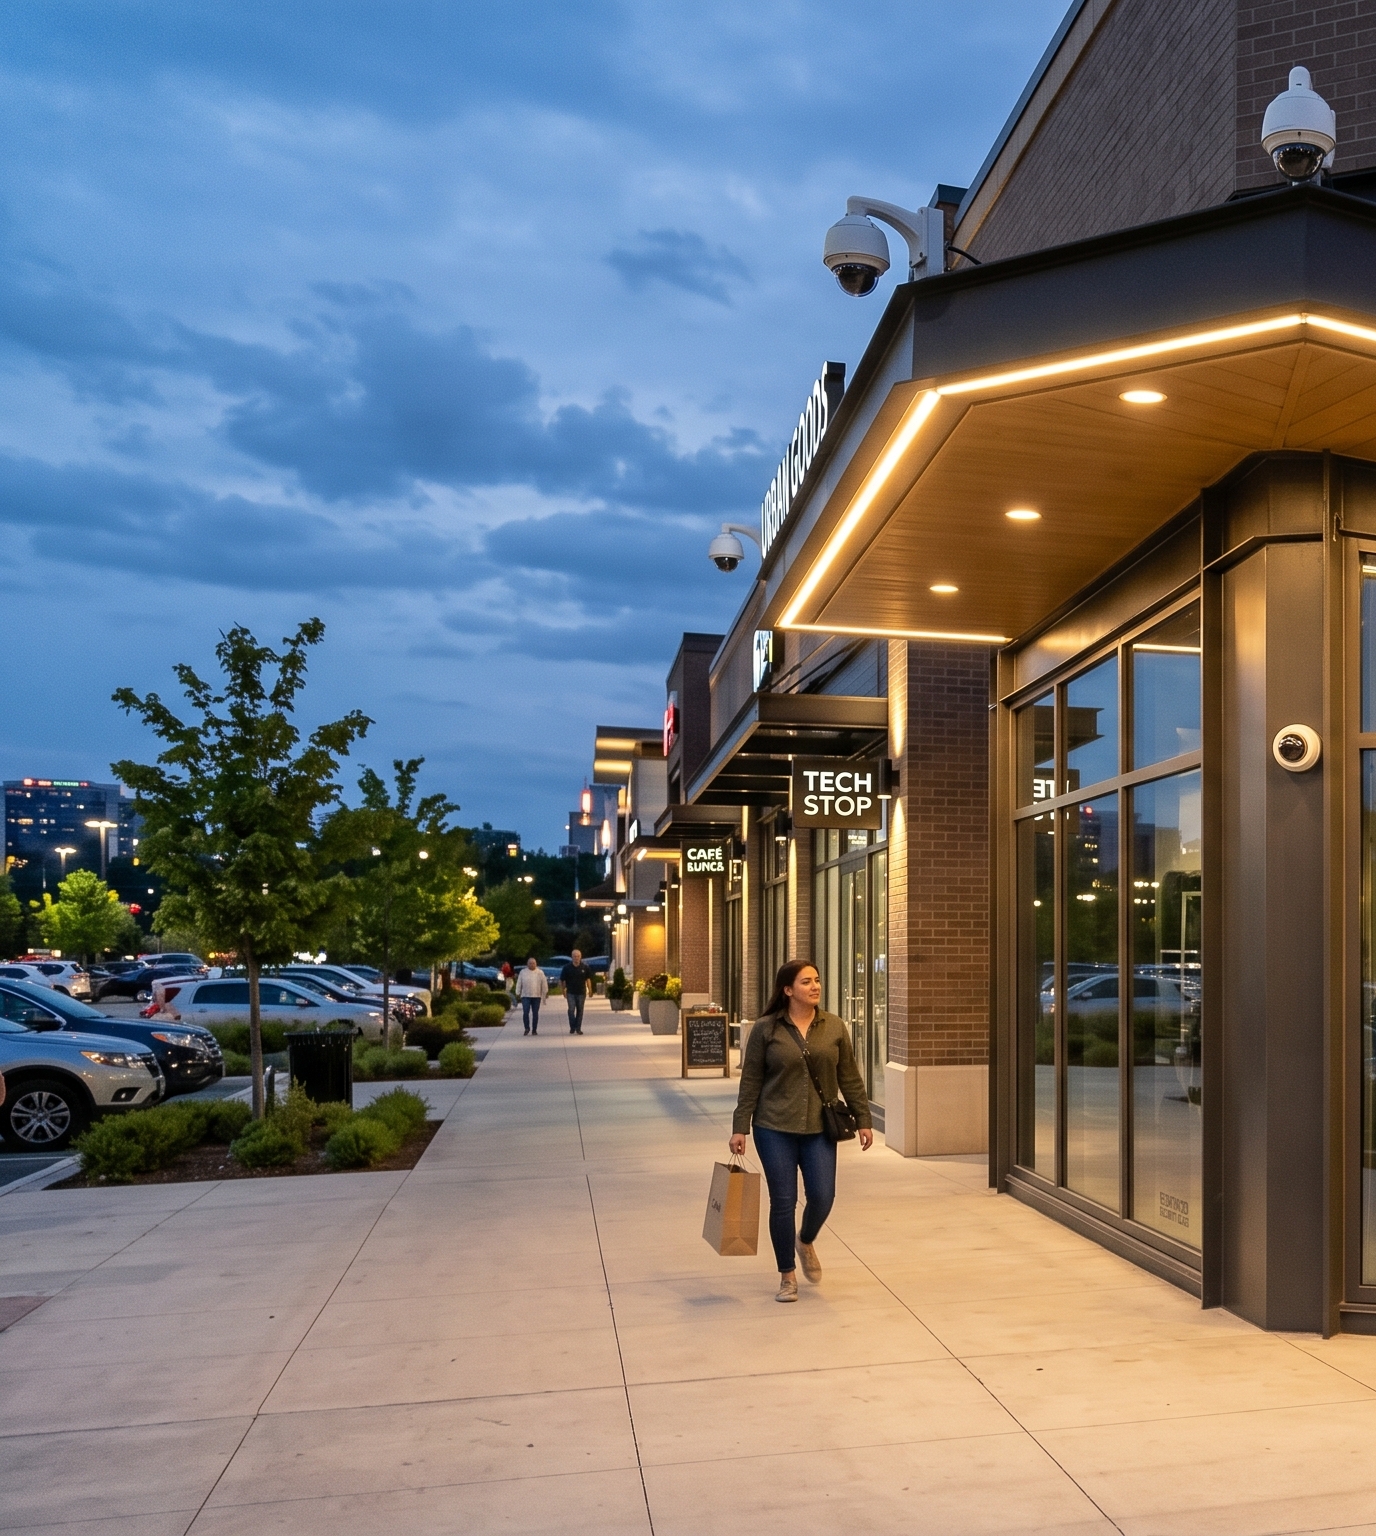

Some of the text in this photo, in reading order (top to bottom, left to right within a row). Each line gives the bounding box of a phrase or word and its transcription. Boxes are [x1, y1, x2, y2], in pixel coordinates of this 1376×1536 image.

[761, 360, 829, 559] URBAN GOODS
[802, 770, 872, 793] TECH
[803, 794, 872, 817] STOP
[686, 846, 723, 860] CAFÉ
